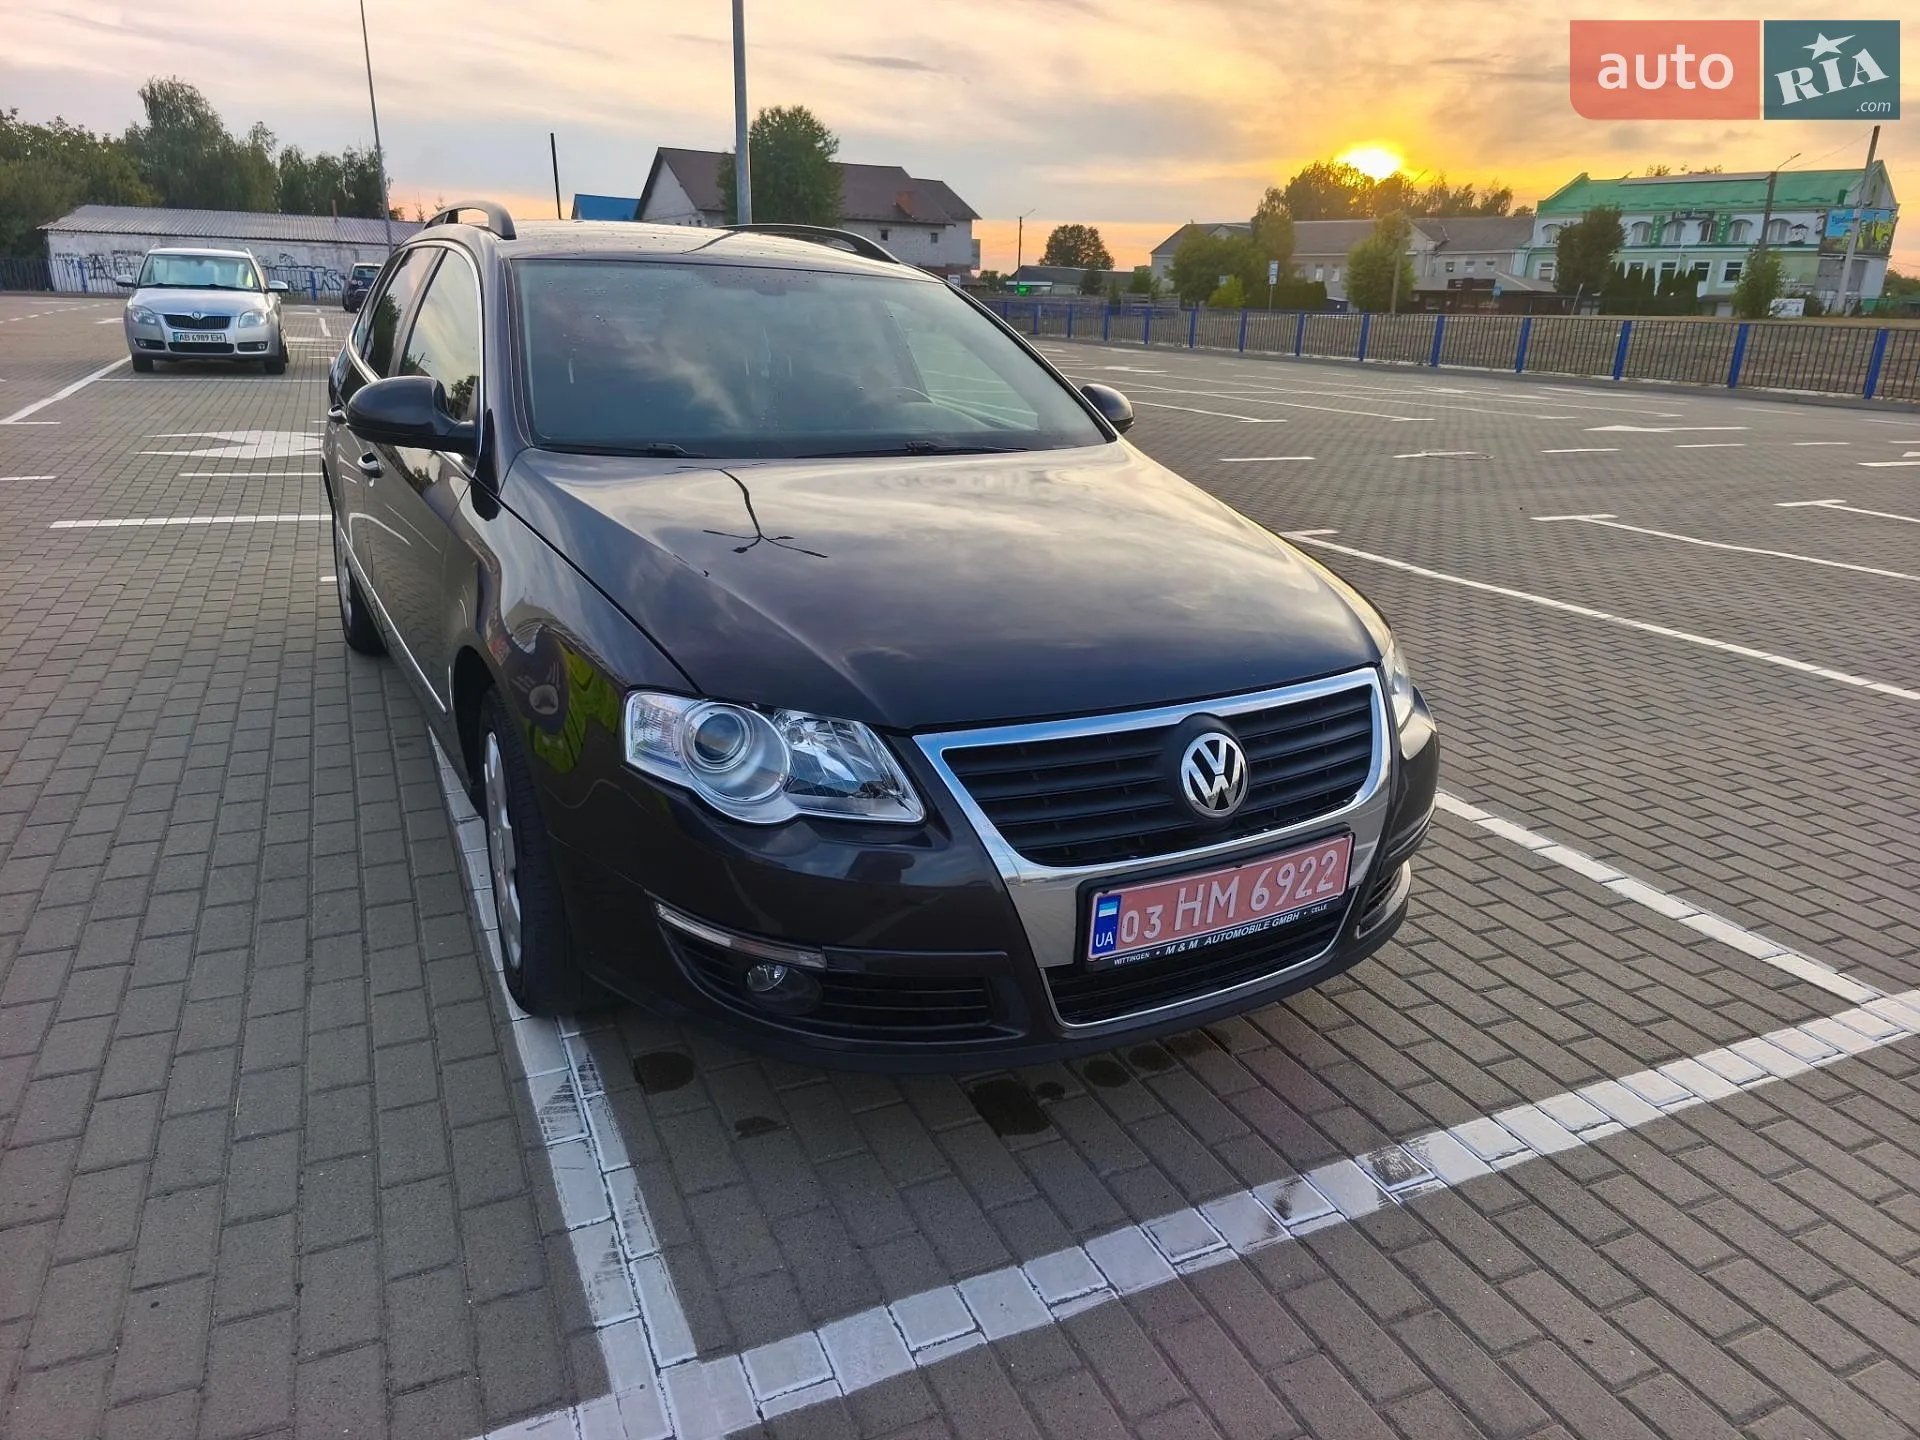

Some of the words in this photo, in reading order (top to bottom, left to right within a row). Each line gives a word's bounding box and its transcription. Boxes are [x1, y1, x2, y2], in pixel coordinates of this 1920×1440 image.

[1181, 732, 1248, 817] VW
[1120, 904, 1164, 944] 03
[1174, 877, 1241, 931] HM
[1250, 849, 1338, 912] 6922
[1095, 931, 1114, 948] UA
[1114, 952, 1150, 965] WITTINGEN
[1165, 946, 1176, 955] M
[1178, 943, 1186, 952] &
[1188, 939, 1199, 949] M
[1204, 920, 1271, 946] AUTOMOBILE
[1272, 911, 1300, 927] GMBH
[1311, 904, 1328, 914] CELLE
